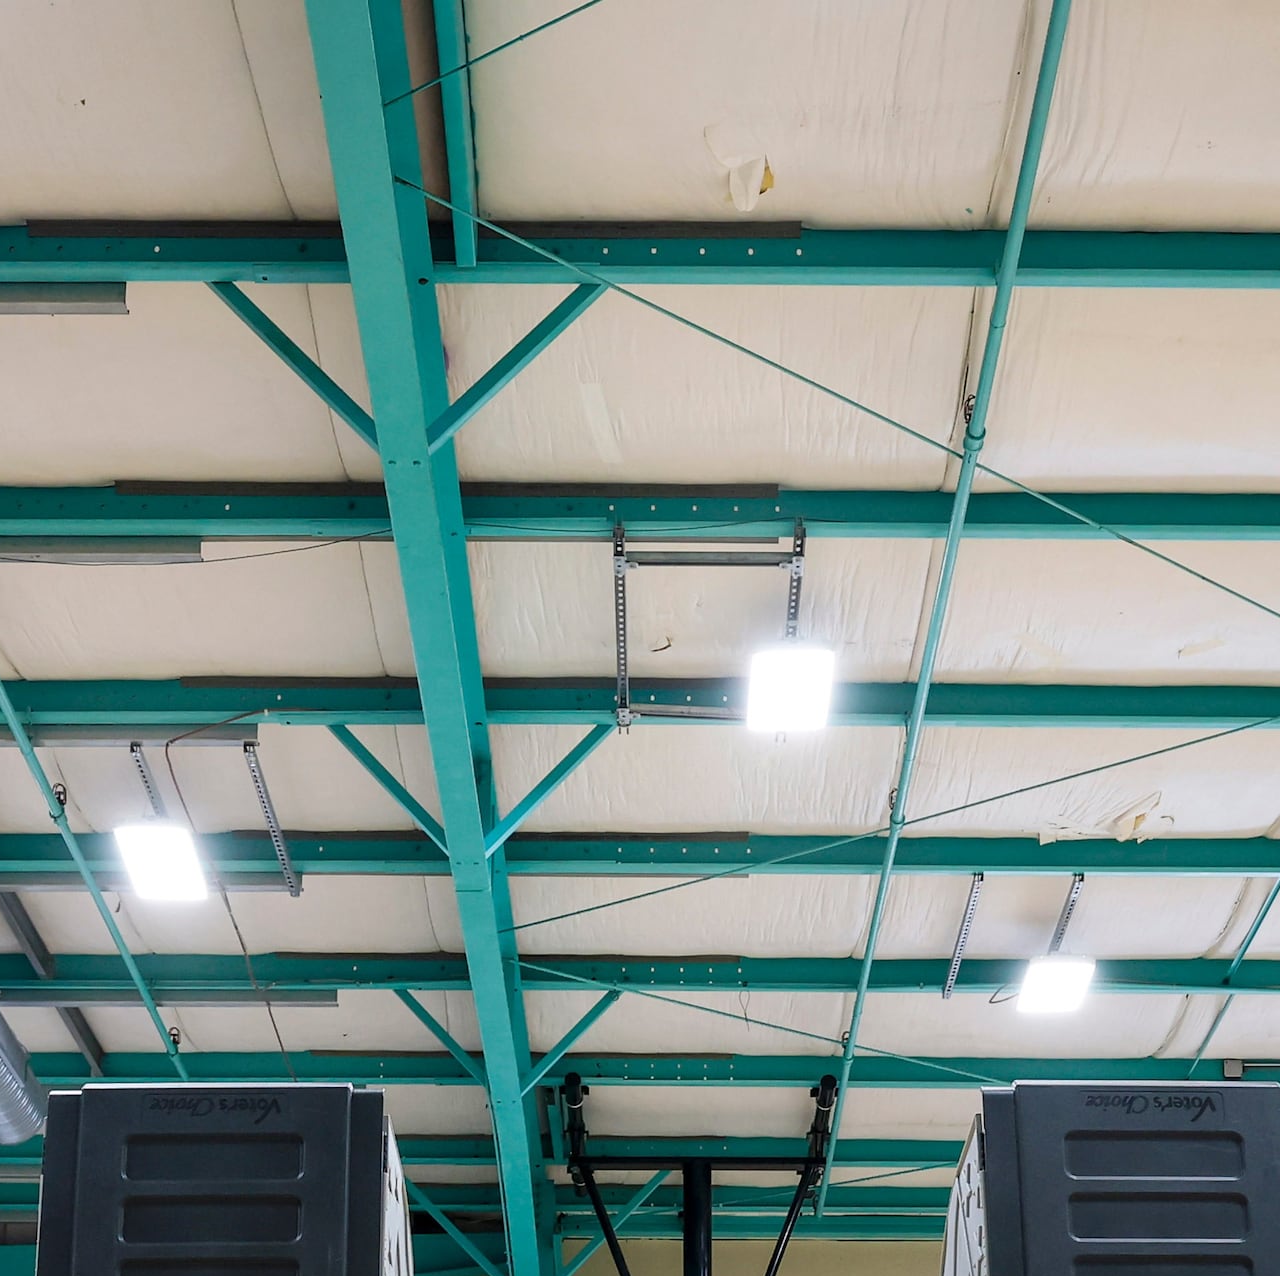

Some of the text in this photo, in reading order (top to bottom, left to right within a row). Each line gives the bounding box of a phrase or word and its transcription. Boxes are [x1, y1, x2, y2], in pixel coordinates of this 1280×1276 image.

[219, 1096, 282, 1125] Voter's
[1085, 1094, 1217, 1123] Voter's Choice
